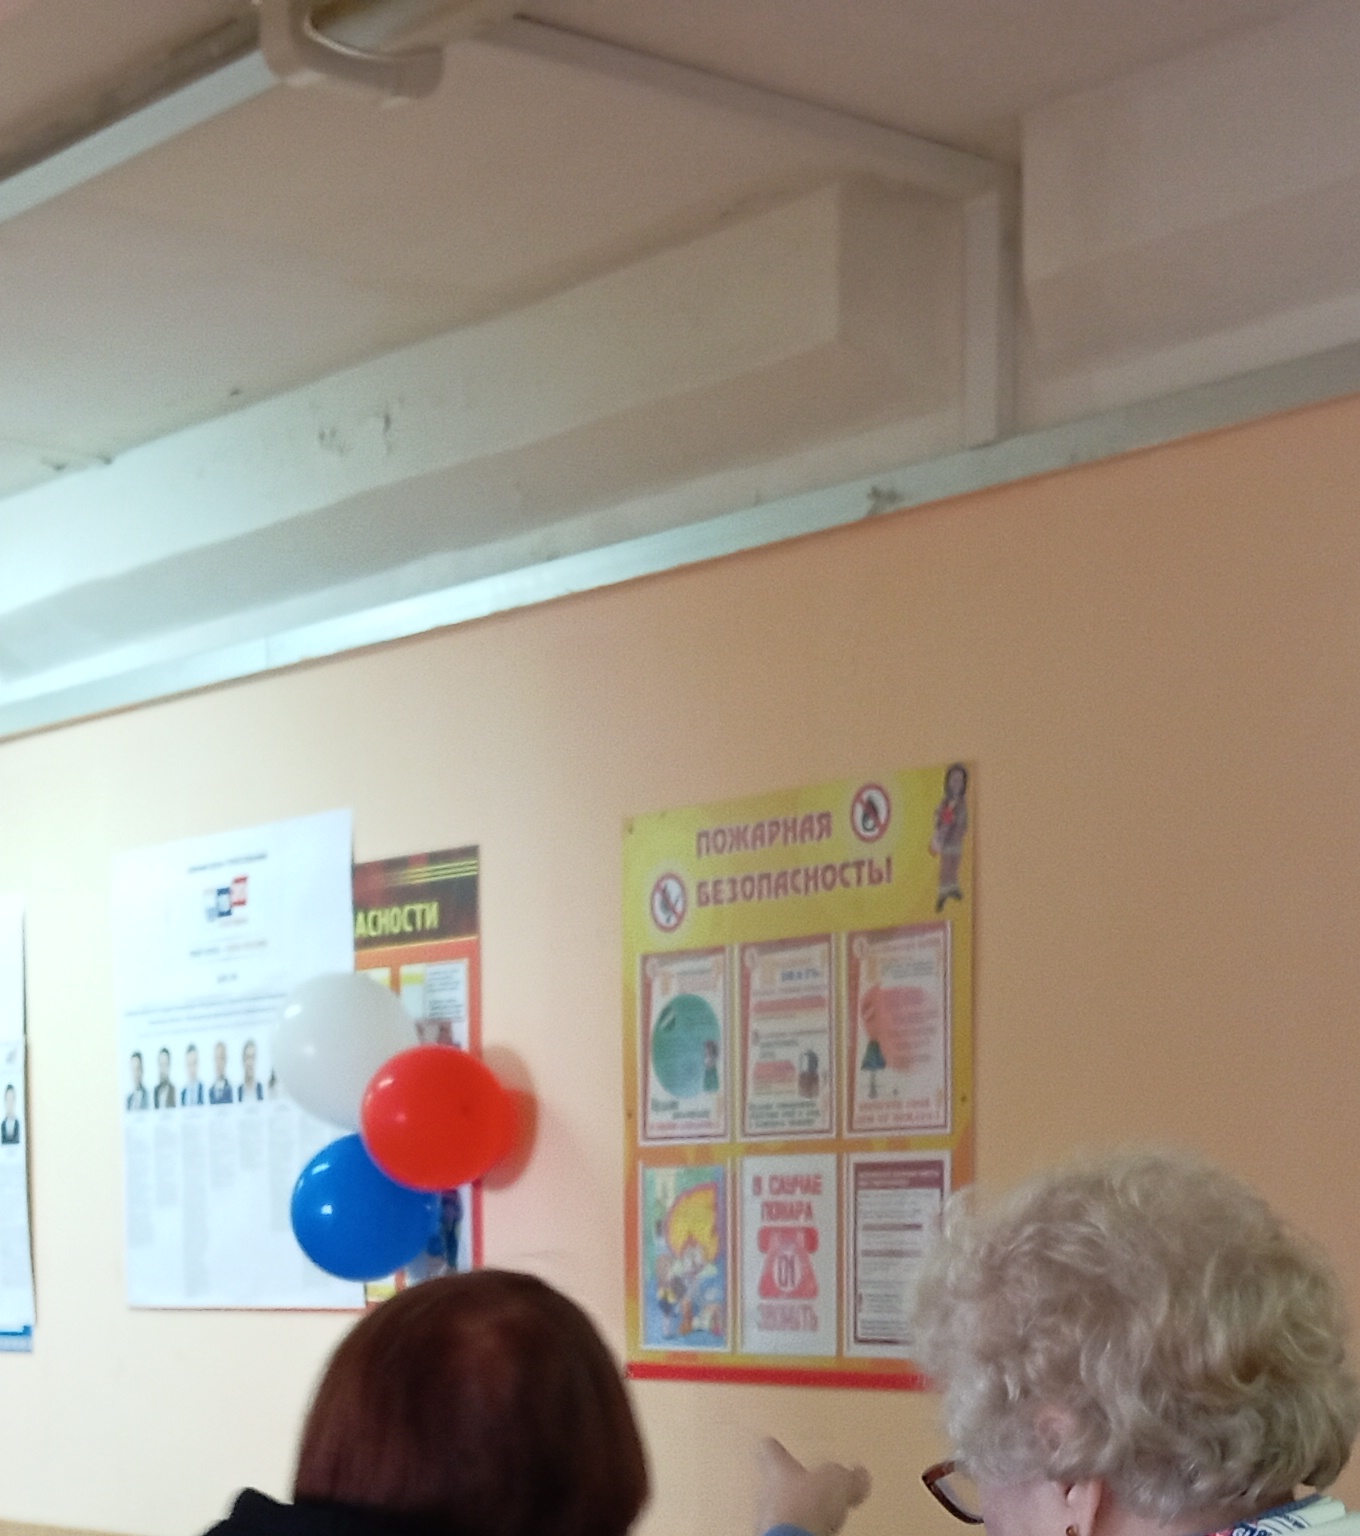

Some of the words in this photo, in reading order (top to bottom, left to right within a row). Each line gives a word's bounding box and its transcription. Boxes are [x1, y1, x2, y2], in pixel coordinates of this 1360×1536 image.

[697, 811, 832, 859] ПОЖАРНАЯ
[697, 856, 892, 908] БЕЗОПАСНОСТЬ!
[777, 1254, 795, 1288] 01
